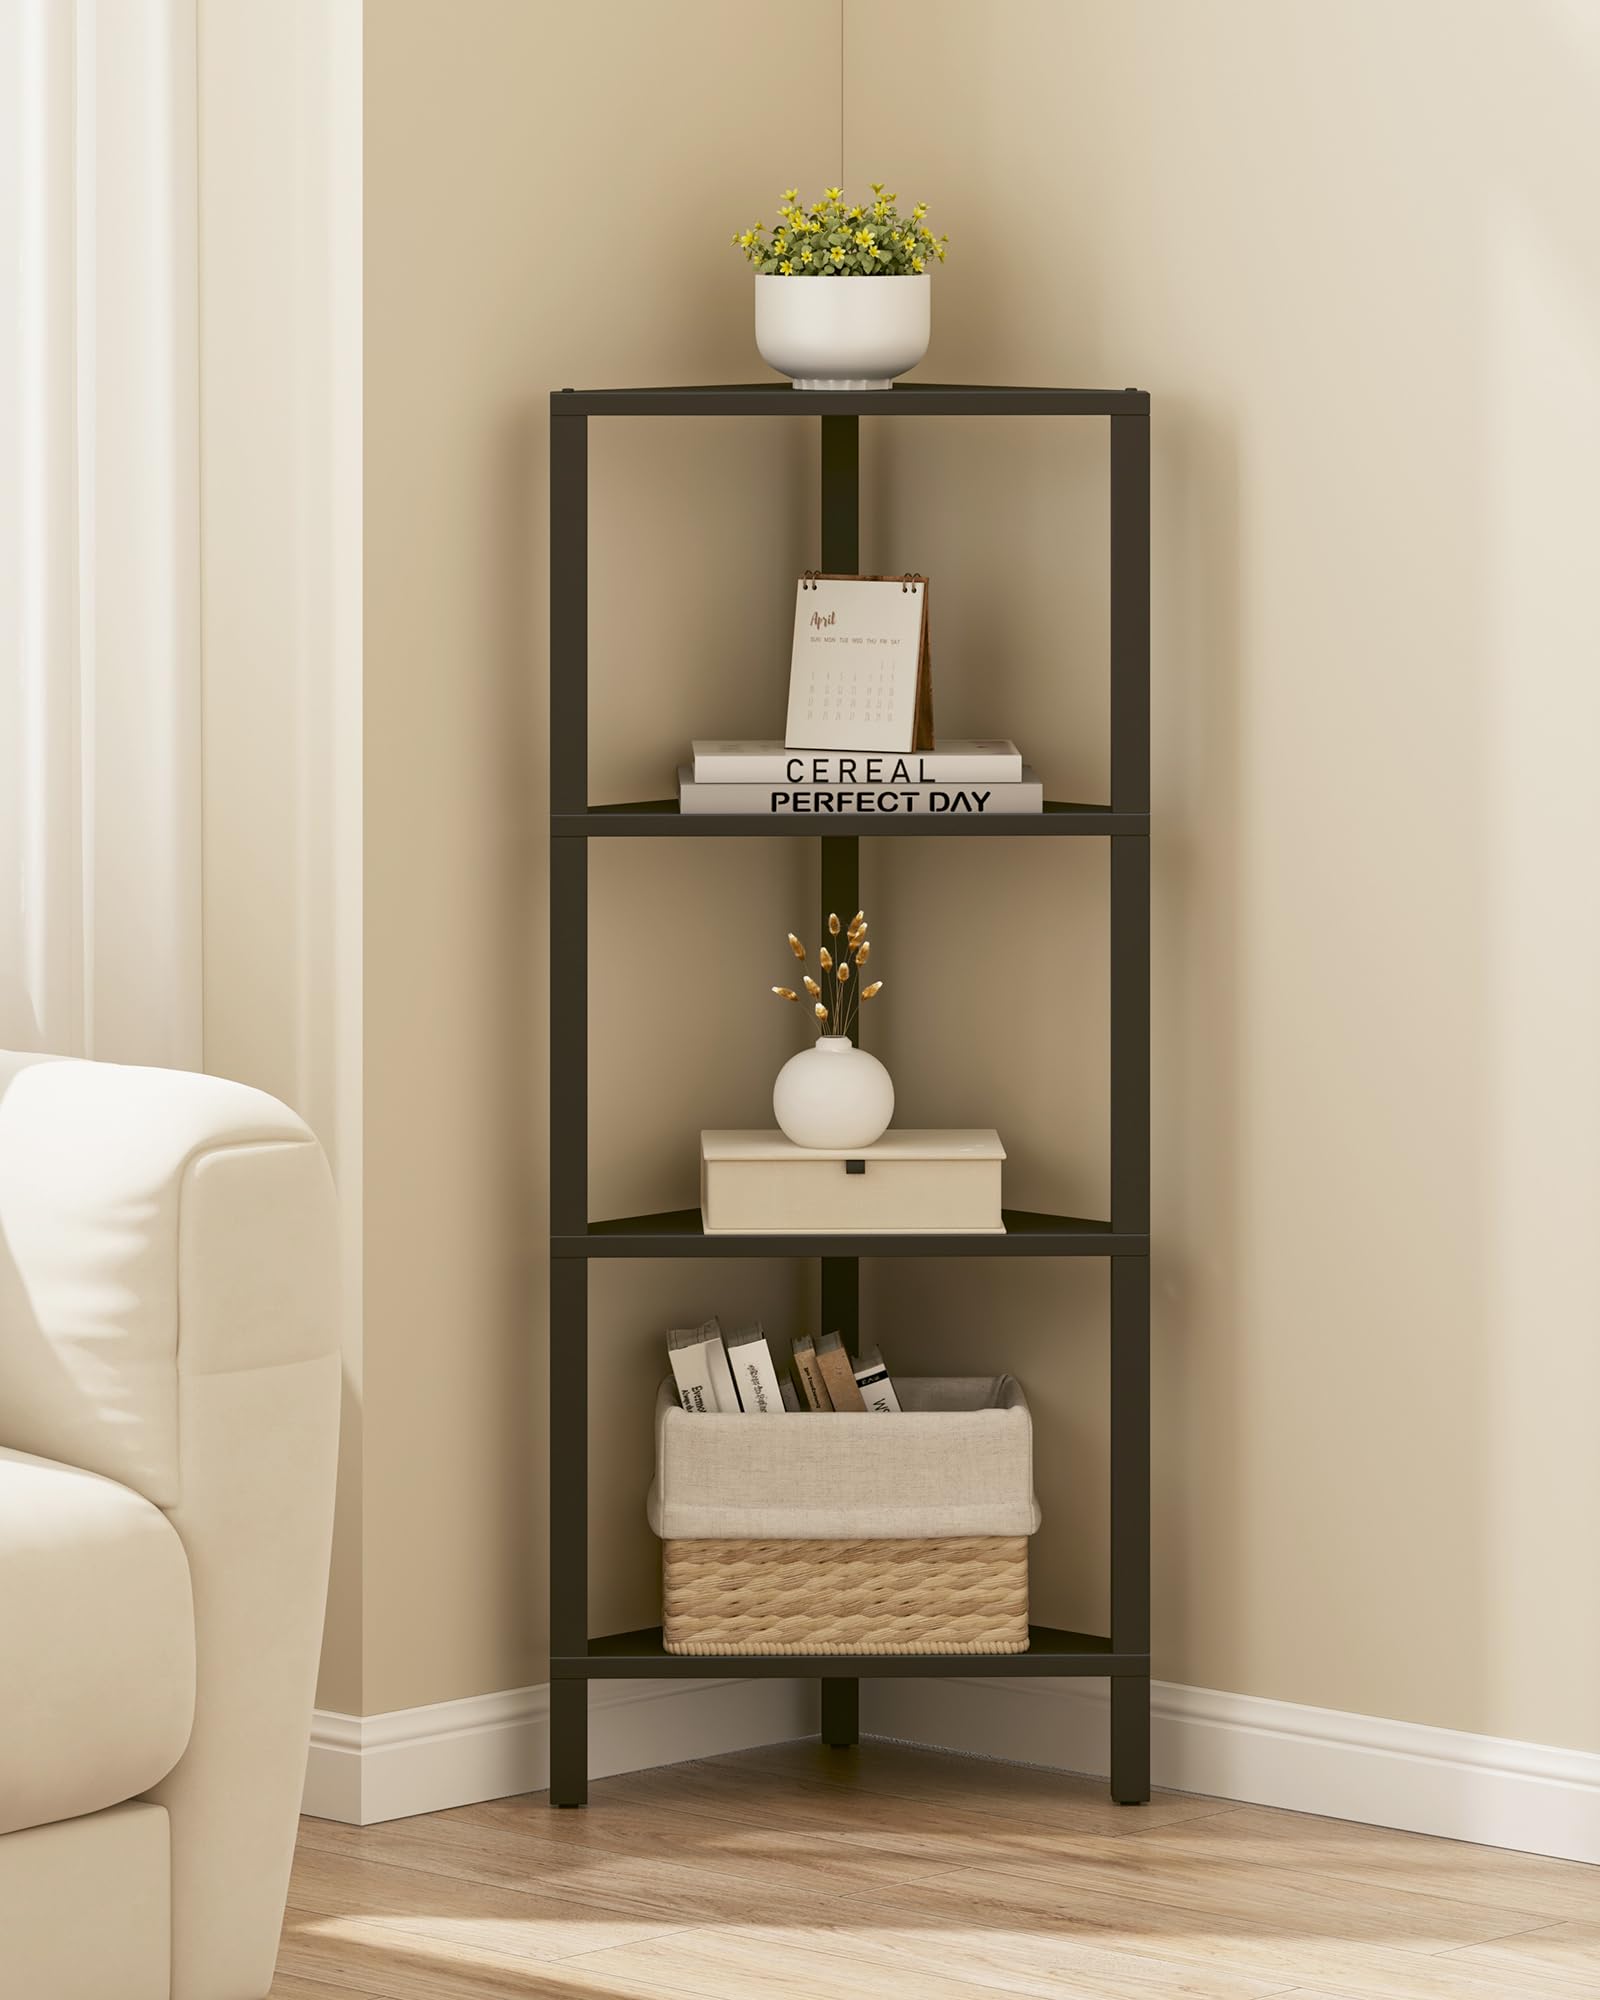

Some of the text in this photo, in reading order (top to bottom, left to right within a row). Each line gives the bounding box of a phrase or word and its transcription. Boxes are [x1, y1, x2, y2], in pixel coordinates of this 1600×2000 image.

[810, 611, 836, 630] April
[786, 758, 936, 783] CEREAL
[771, 791, 992, 813] PERFECT DAY
